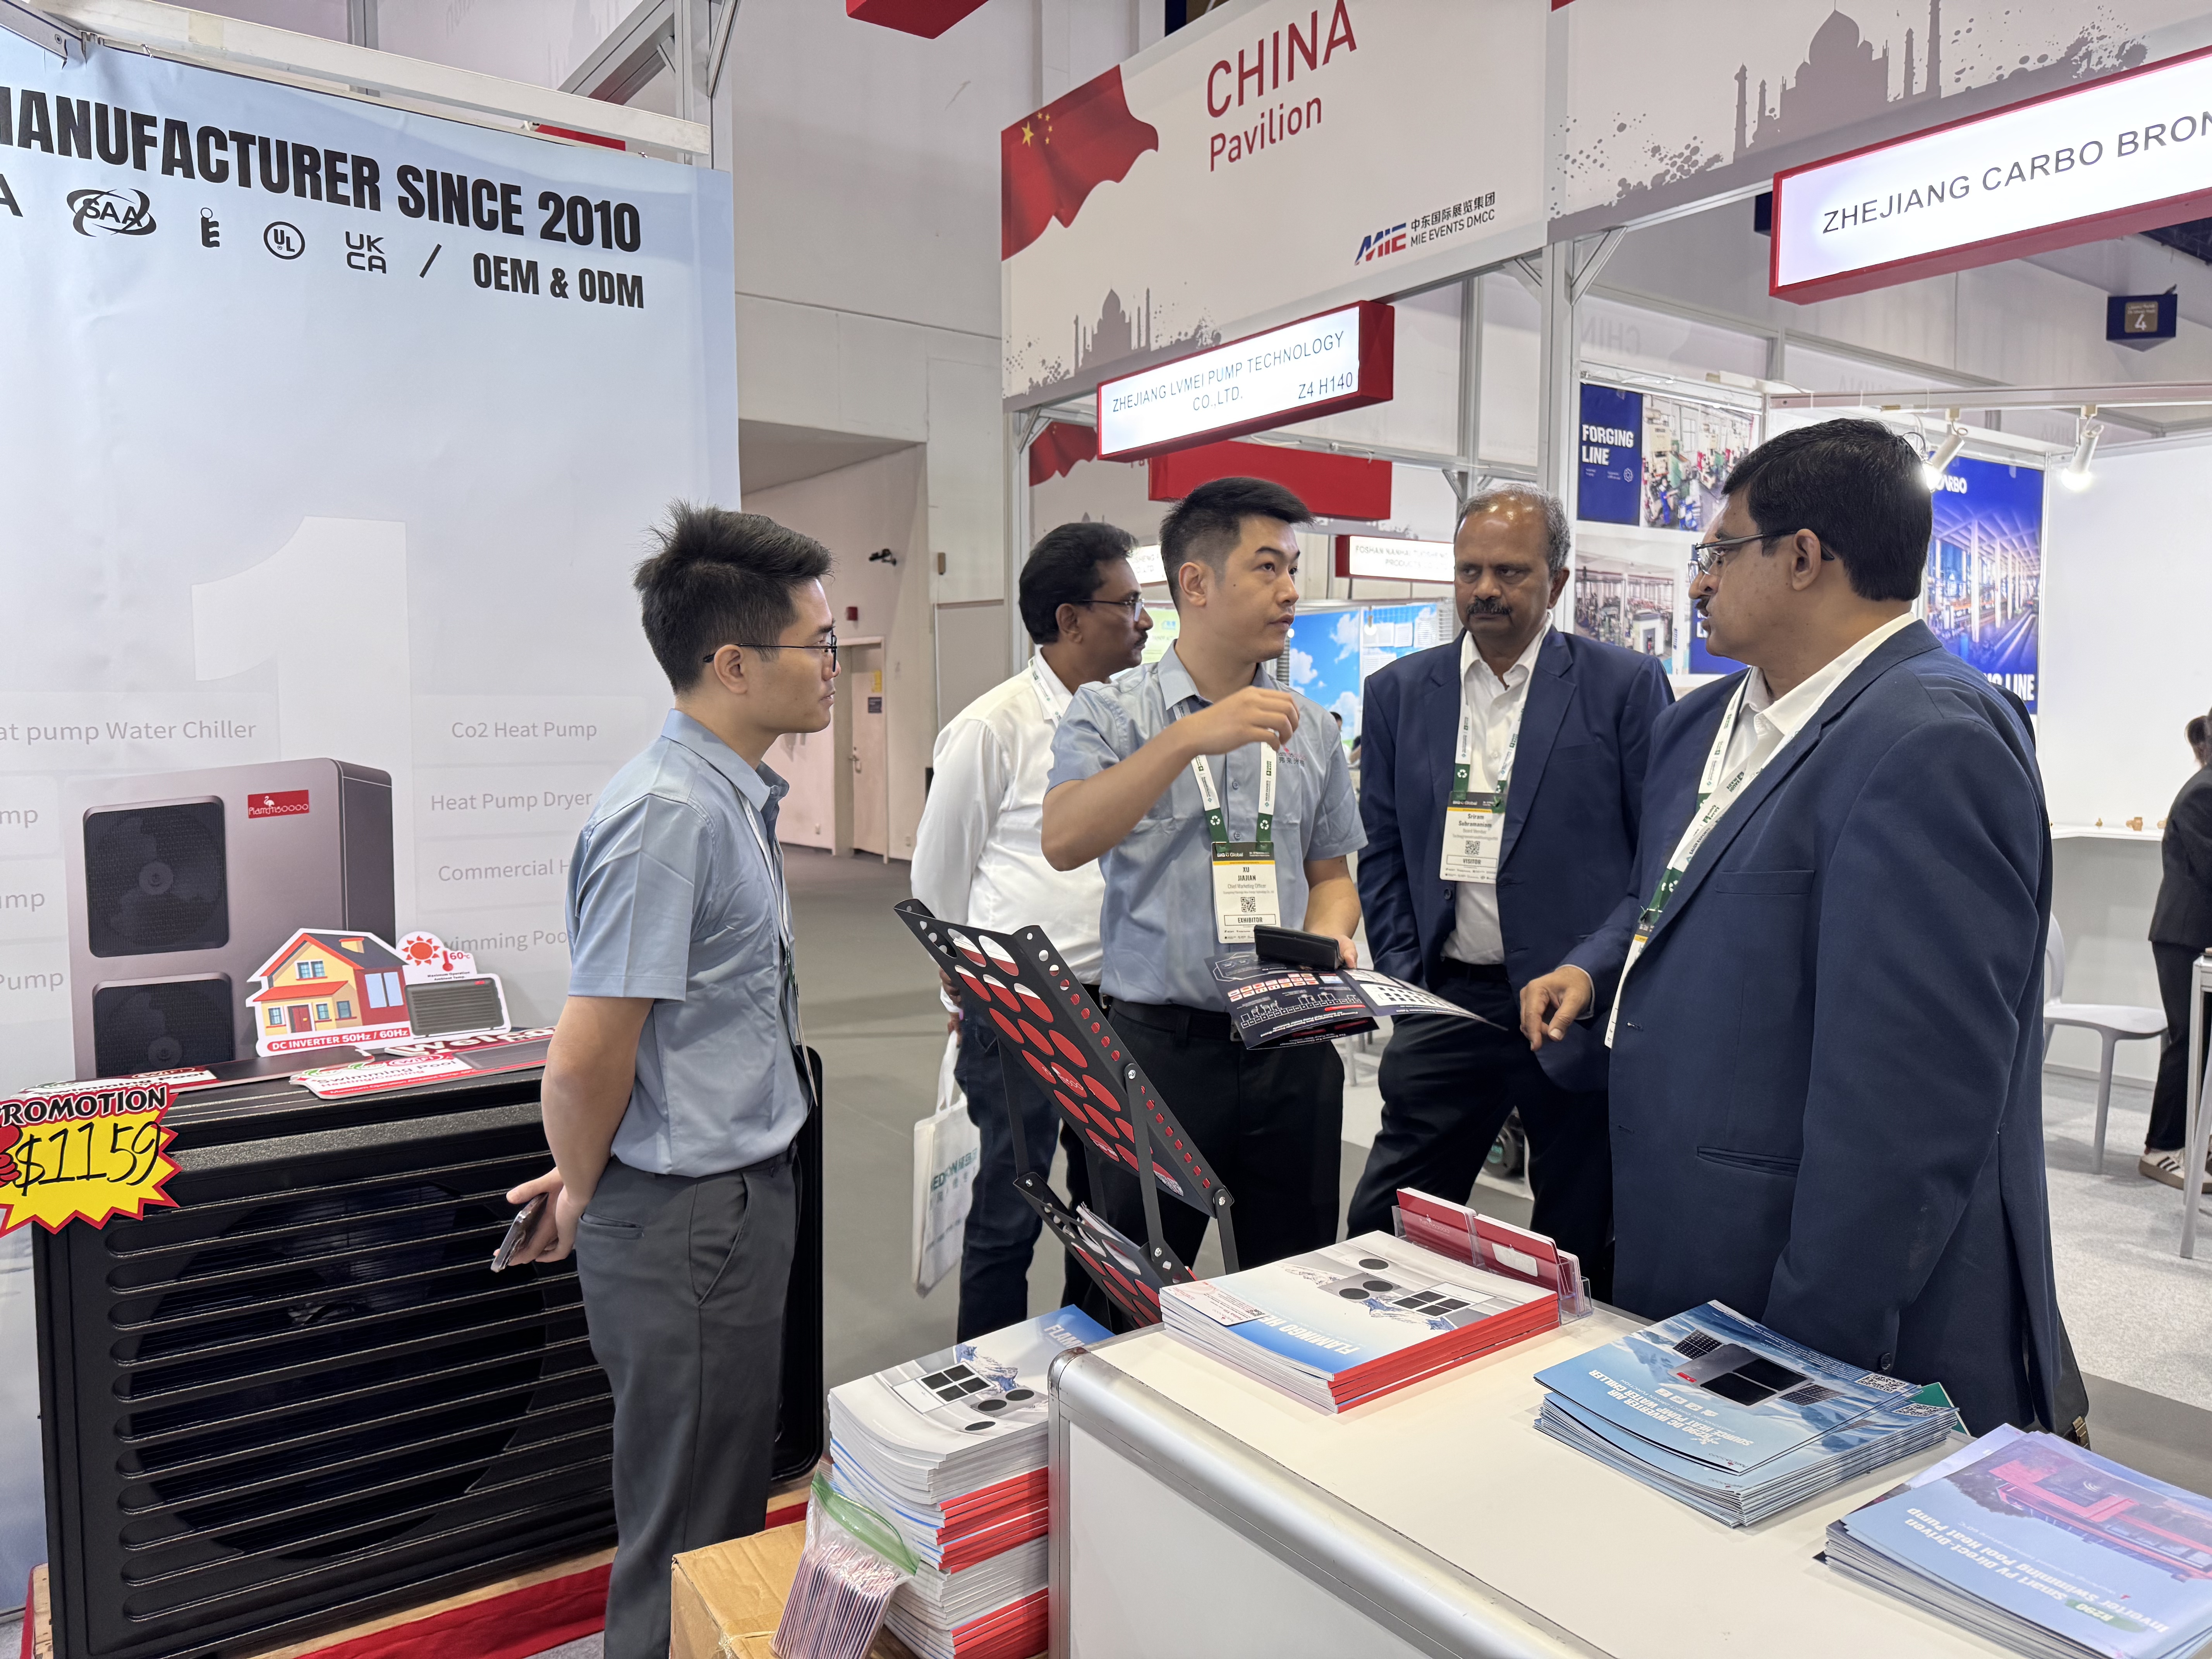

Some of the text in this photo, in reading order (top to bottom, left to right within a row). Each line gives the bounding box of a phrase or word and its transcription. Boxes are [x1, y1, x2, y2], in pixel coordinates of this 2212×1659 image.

[1207, 0, 1357, 118] CHINA
[1210, 97, 1322, 172] Pavilion
[1822, 176, 1970, 234] ZHEJIANG
[1982, 141, 2103, 191] CARBO
[397, 164, 524, 236] SINCE
[538, 191, 641, 252] 2010
[1411, 191, 1496, 233] 中东国际展览集团
[1410, 209, 1496, 247] MIE EVENTS DMCC
[273, 228, 295, 253] UL
[345, 231, 385, 254] UK
[346, 252, 386, 274] CA
[473, 252, 539, 295] OEM
[550, 268, 569, 299] &
[579, 268, 644, 309] ODM
[2134, 313, 2147, 331] 4
[1113, 331, 1345, 413] ZHEJIANG LVMEI PUMP TECHNOLOGY
[1298, 383, 1314, 400] Z4
[1319, 372, 1353, 395] H140
[1581, 424, 1635, 448] FORGING
[1581, 445, 1610, 466] LINE
[27, 725, 99, 745] pump
[106, 722, 177, 740] Water
[182, 720, 257, 739] Chiller
[452, 721, 598, 740] Co2 Heat Pump
[431, 791, 593, 811] Heat Pump Dryer
[438, 859, 554, 882] Commercial
[443, 930, 567, 951] wimming Poo
[271, 1041, 287, 1051] DC
[288, 1035, 340, 1049] INVERTER
[342, 1032, 372, 1044] 50Hz
[379, 1027, 409, 1039] 60Hz
[397, 1029, 555, 1053] Welco
[416, 1060, 457, 1070] Pool
[0, 1086, 167, 1125] ROMOTION
[1257, 1315, 1276, 1328] HE
[1044, 1324, 1085, 1349] FLAMI
[1279, 1324, 1360, 1355] FLAMINGO
[1607, 1389, 1627, 1400] AIR
[1589, 1369, 1754, 1446] SOURCE HEAT PUMP WATER CHILLER
[1623, 1399, 1669, 1422] INVERTER
[1667, 1420, 1685, 1429] DC
[1906, 1508, 1949, 1532] Pump
[1905, 1518, 1999, 1570] Direct-Driven
[1946, 1529, 1983, 1551] Heat
[1980, 1546, 2017, 1566] Pool
[1995, 1565, 2020, 1580] PV
[2015, 1563, 2099, 1602] Swimming
[2018, 1575, 2068, 1601] Smart
